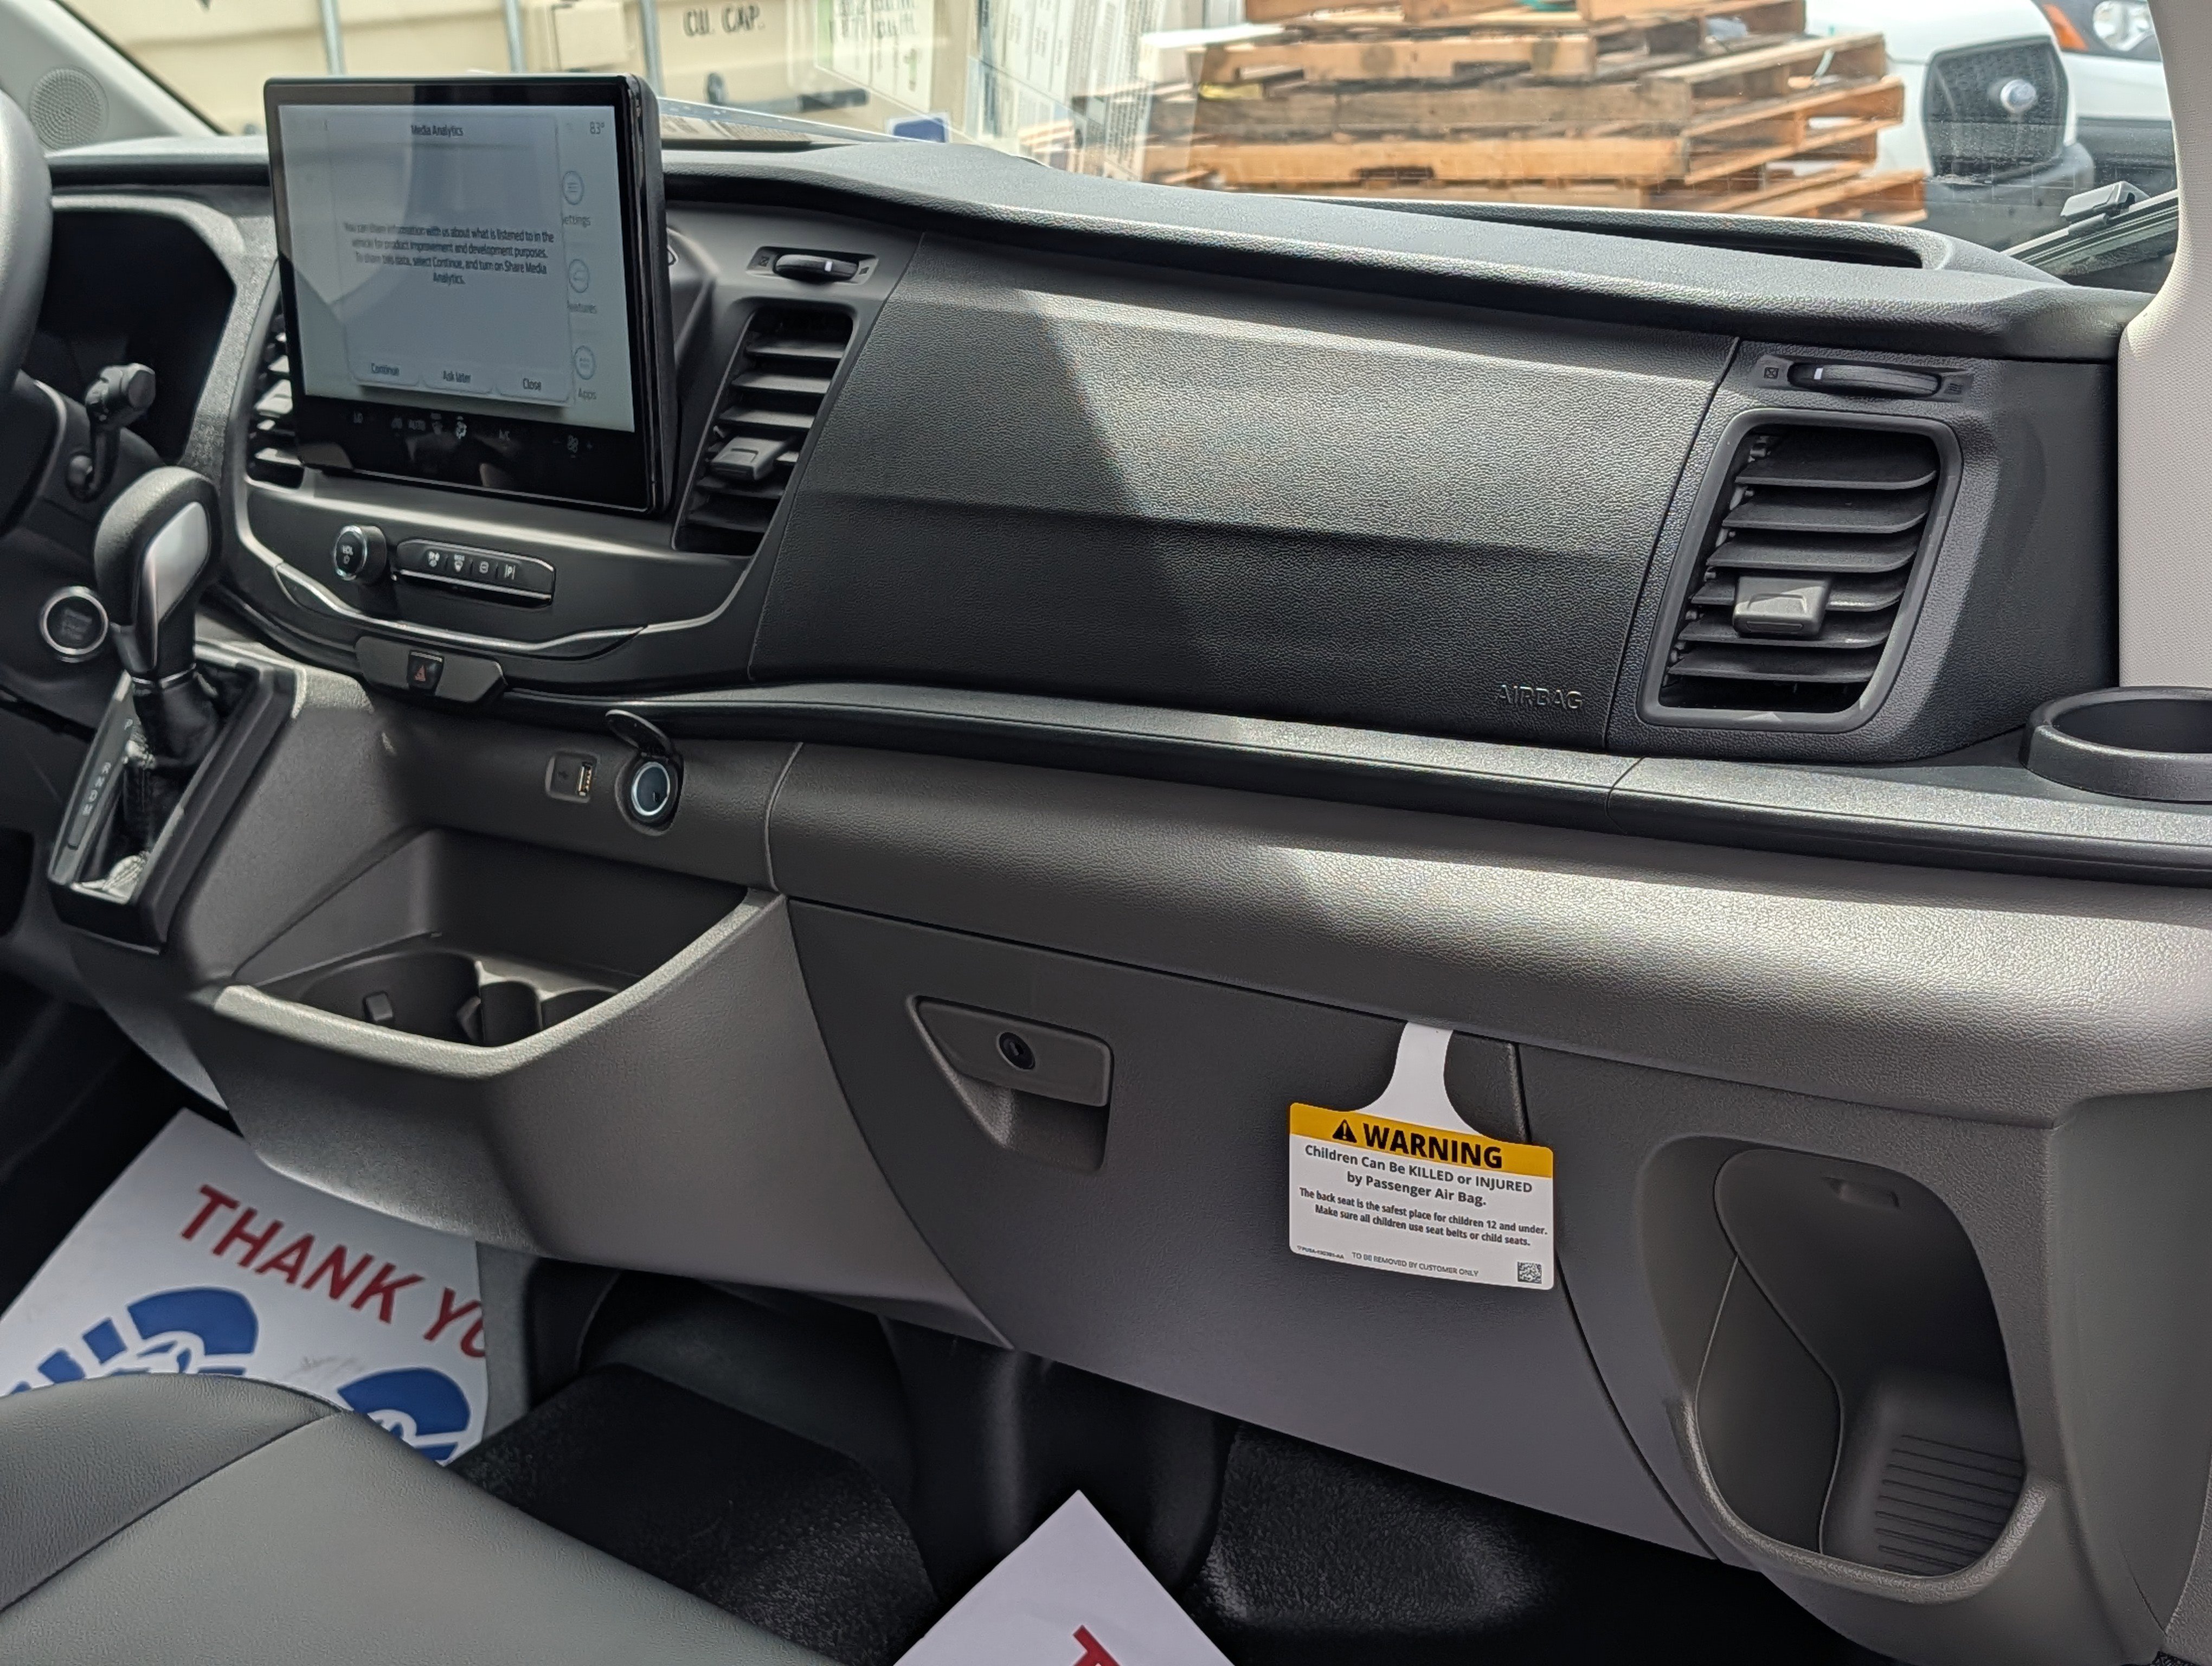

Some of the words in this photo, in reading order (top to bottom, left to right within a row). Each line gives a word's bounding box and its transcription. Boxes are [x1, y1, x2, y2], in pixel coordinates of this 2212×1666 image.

[411, 125, 432, 136] Media
[432, 125, 464, 138] Analytics
[562, 215, 590, 228] ettings
[451, 227, 470, 238] about
[471, 227, 488, 239] what
[490, 228, 496, 240] is
[497, 228, 524, 242] listened
[525, 231, 533, 242] to
[542, 231, 554, 243] the
[455, 244, 467, 254] and
[468, 244, 513, 256] development
[514, 247, 548, 259] purposes.
[465, 259, 478, 270] and
[504, 260, 524, 273] Share
[525, 261, 548, 274] Media
[443, 370, 455, 381] Ask
[522, 378, 542, 391] Close
[1496, 684, 1583, 709] AIRBAG
[1363, 1123, 1502, 1169] WARNING
[1305, 1144, 1358, 1165] Children
[1361, 1157, 1385, 1170] Can
[1389, 1162, 1405, 1174] Be
[1409, 1164, 1454, 1182] KILLED
[1457, 1175, 1472, 1185] or
[1476, 1176, 1533, 1193] INJURED
[1347, 1171, 1363, 1187] by
[1366, 1176, 1431, 1197] Passenger
[1435, 1188, 1455, 1201] Air
[1458, 1191, 1487, 1207] Bag.
[1299, 1187, 1315, 1199] The
[1316, 1190, 1335, 1203] back
[1337, 1196, 1355, 1207] seat
[1356, 1198, 1364, 1209] is
[1366, 1201, 1380, 1212] the
[1381, 1204, 1407, 1216] safest
[1409, 1209, 1431, 1220] place
[1433, 1212, 1446, 1222] for
[1448, 1215, 1484, 1228] children
[1486, 1220, 1497, 1229] 12
[1499, 1222, 1516, 1232] and
[1518, 1225, 1548, 1235] under.
[1315, 1204, 1338, 1217] Make
[1340, 1210, 1358, 1221] sure
[1359, 1213, 1371, 1223] all
[1372, 1215, 1407, 1229] children
[1409, 1223, 1424, 1233] use
[1425, 1225, 1444, 1235] seat
[1446, 1227, 1468, 1239] belts
[1481, 1232, 1503, 1243] child
[1504, 1236, 1531, 1246] seats.
[179, 1184, 426, 1324] THANK
[1373, 1256, 1407, 1267] REMOVED
[1419, 1263, 1458, 1274] CUSTOMER
[1458, 1268, 1479, 1277] ONLY
